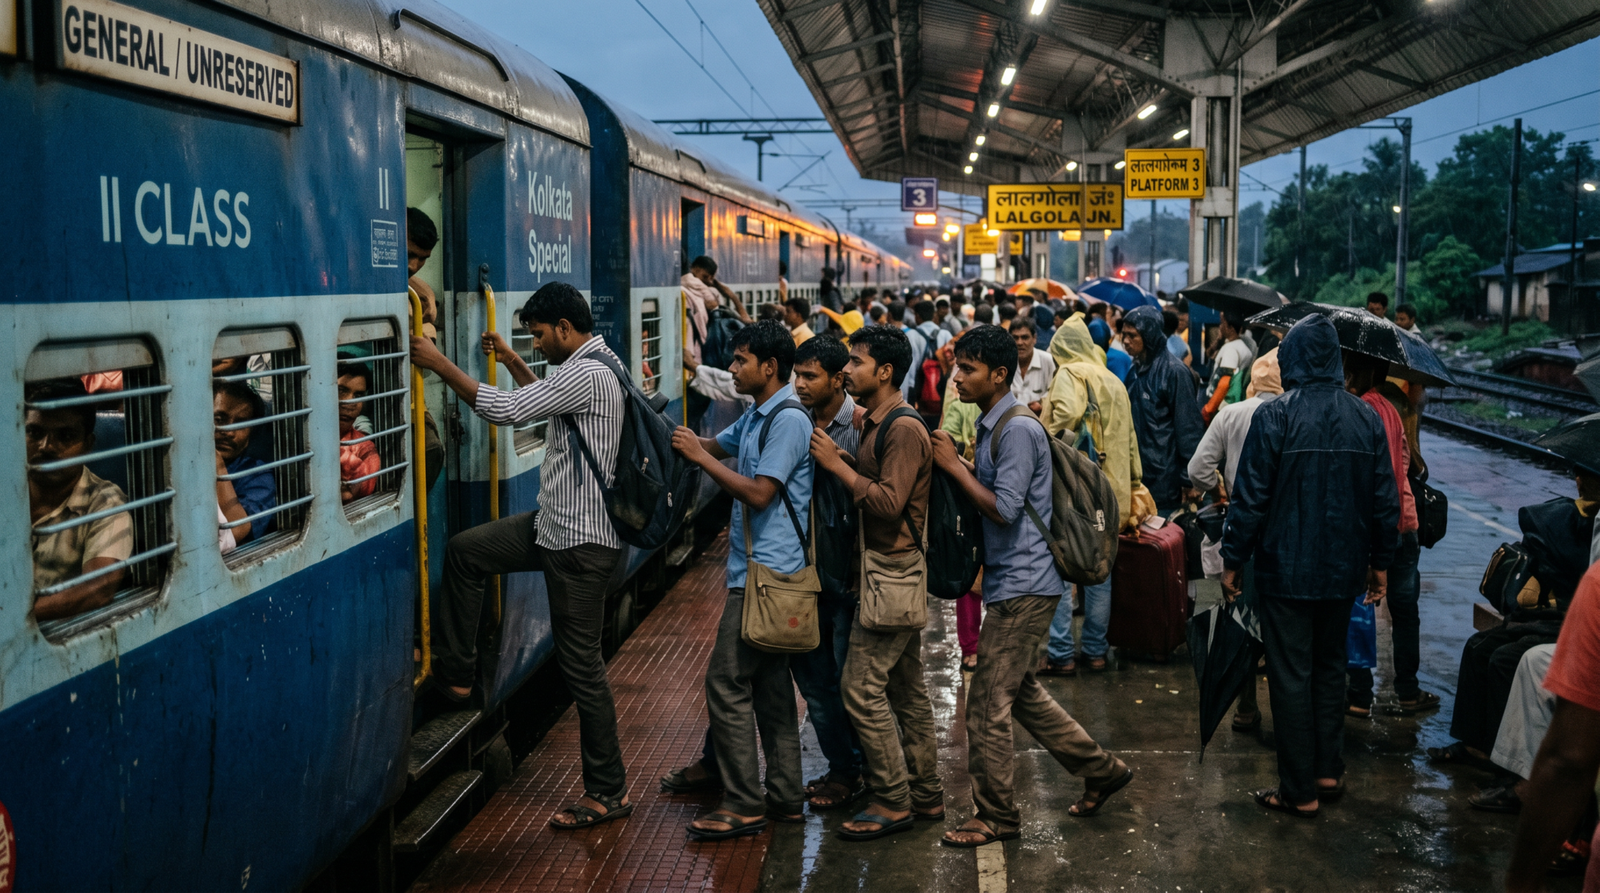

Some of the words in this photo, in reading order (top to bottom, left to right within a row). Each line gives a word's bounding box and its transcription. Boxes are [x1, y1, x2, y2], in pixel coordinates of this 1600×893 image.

[64, 5, 170, 77] GENERAL
[186, 41, 294, 109] UNRESERVED
[1192, 158, 1200, 172] 3
[528, 170, 573, 221] Kolkata
[912, 188, 927, 206] 3
[1131, 178, 1189, 192] PLATFORM
[1192, 177, 1200, 191] 3
[134, 180, 252, 249] CLASS
[995, 210, 1081, 224] LALGOLA
[1086, 210, 1116, 224] JN.
[528, 229, 572, 283] Special
